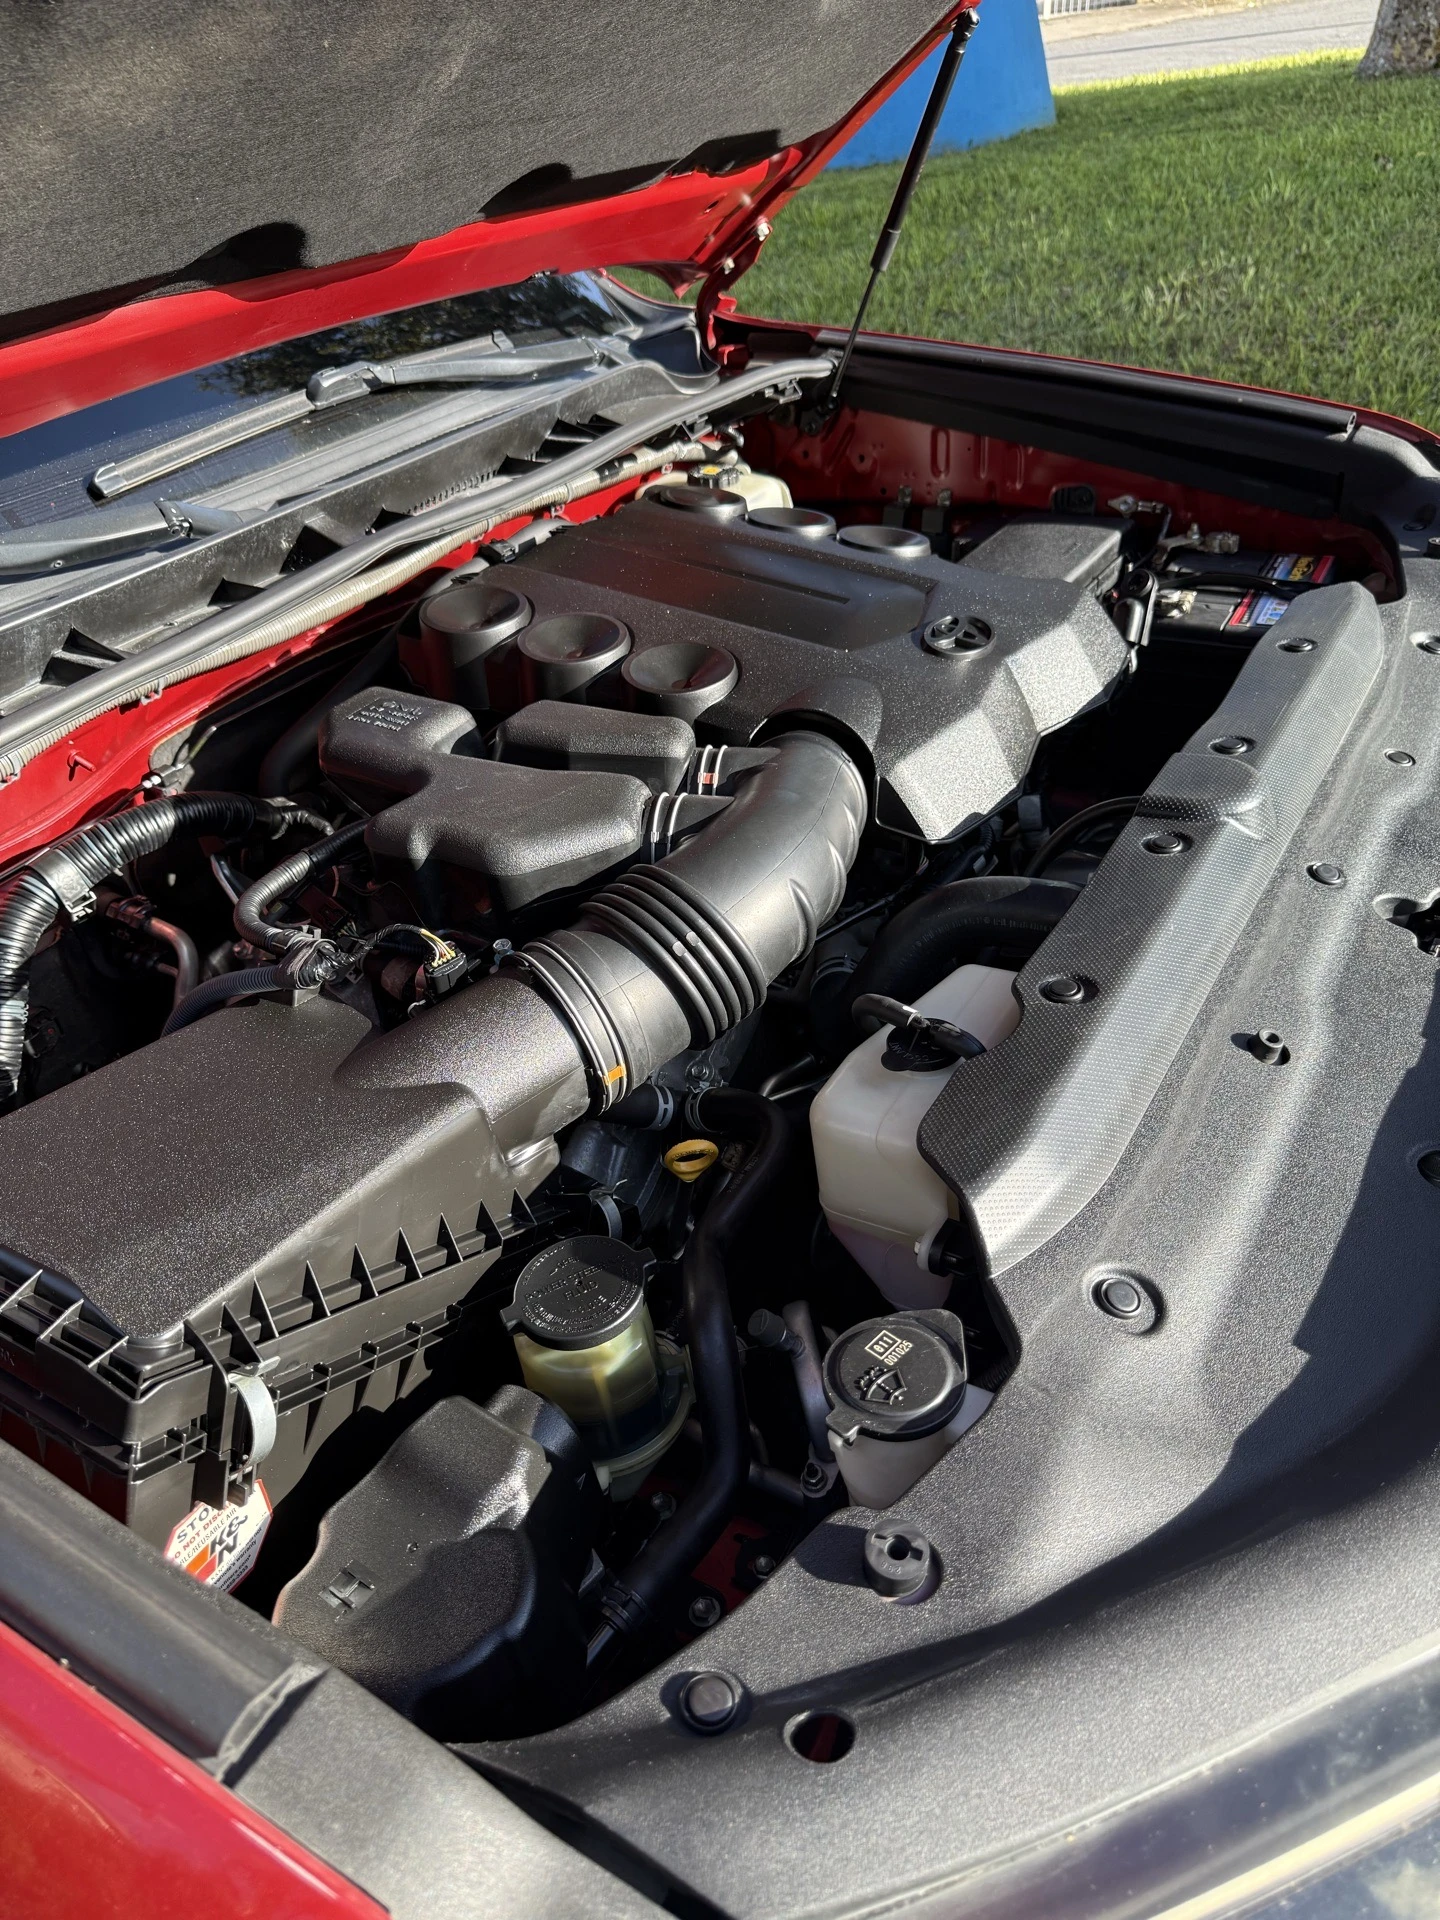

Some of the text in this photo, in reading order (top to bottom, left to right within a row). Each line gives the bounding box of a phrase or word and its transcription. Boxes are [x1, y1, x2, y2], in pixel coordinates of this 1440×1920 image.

[525, 1278, 568, 1302] POWER
[565, 1280, 599, 1301] FLUID
[884, 1340, 913, 1366] 001025
[177, 1507, 215, 1543] STO
[226, 1507, 237, 1521] AIR
[183, 1530, 201, 1551] NOT
[236, 1540, 257, 1562] warranty
